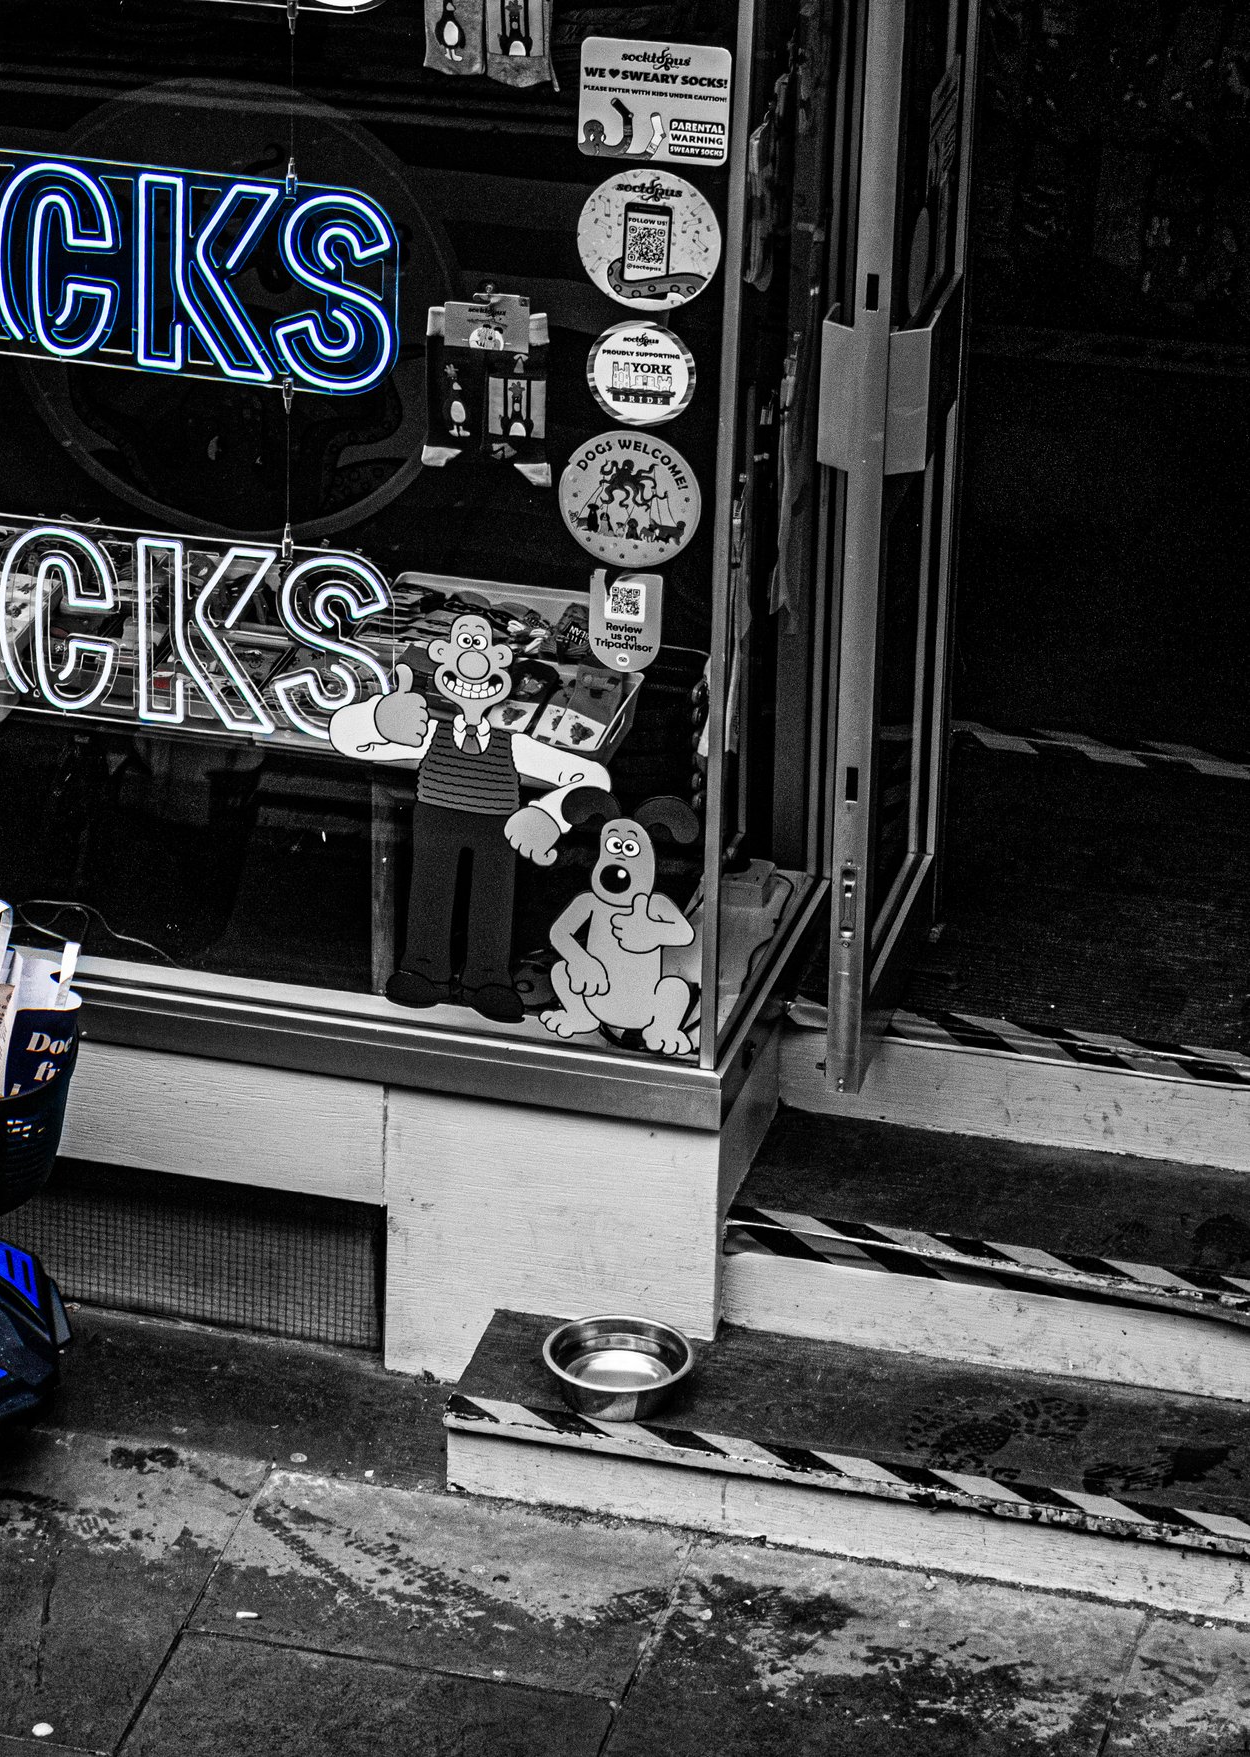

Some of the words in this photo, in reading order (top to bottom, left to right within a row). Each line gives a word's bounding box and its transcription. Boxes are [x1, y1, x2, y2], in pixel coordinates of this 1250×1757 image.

[584, 67, 606, 78] WE
[621, 70, 679, 84] SWEARY
[681, 75, 728, 89] SOCKS!
[583, 84, 607, 92] PLEASE
[631, 88, 651, 96] WITH
[651, 90, 668, 98] KIDS
[669, 92, 693, 100] UNDER
[693, 94, 727, 103] CAUTION!
[671, 121, 724, 134] PARENTAL
[670, 133, 723, 146] WARNING
[670, 145, 699, 155] SWEARY
[700, 149, 723, 157] SOCKS
[615, 176, 683, 202] soctopus
[628, 217, 655, 225] FOLLOW
[602, 349, 634, 357] PROUDLY
[635, 351, 681, 360] SUPPORTING
[631, 362, 672, 375] YORK
[619, 395, 663, 405] PRIDE
[576, 441, 612, 471] DOGS
[618, 439, 688, 490] WELCOME!
[605, 622, 643, 634] Review
[594, 637, 653, 653] Tripadvisor
